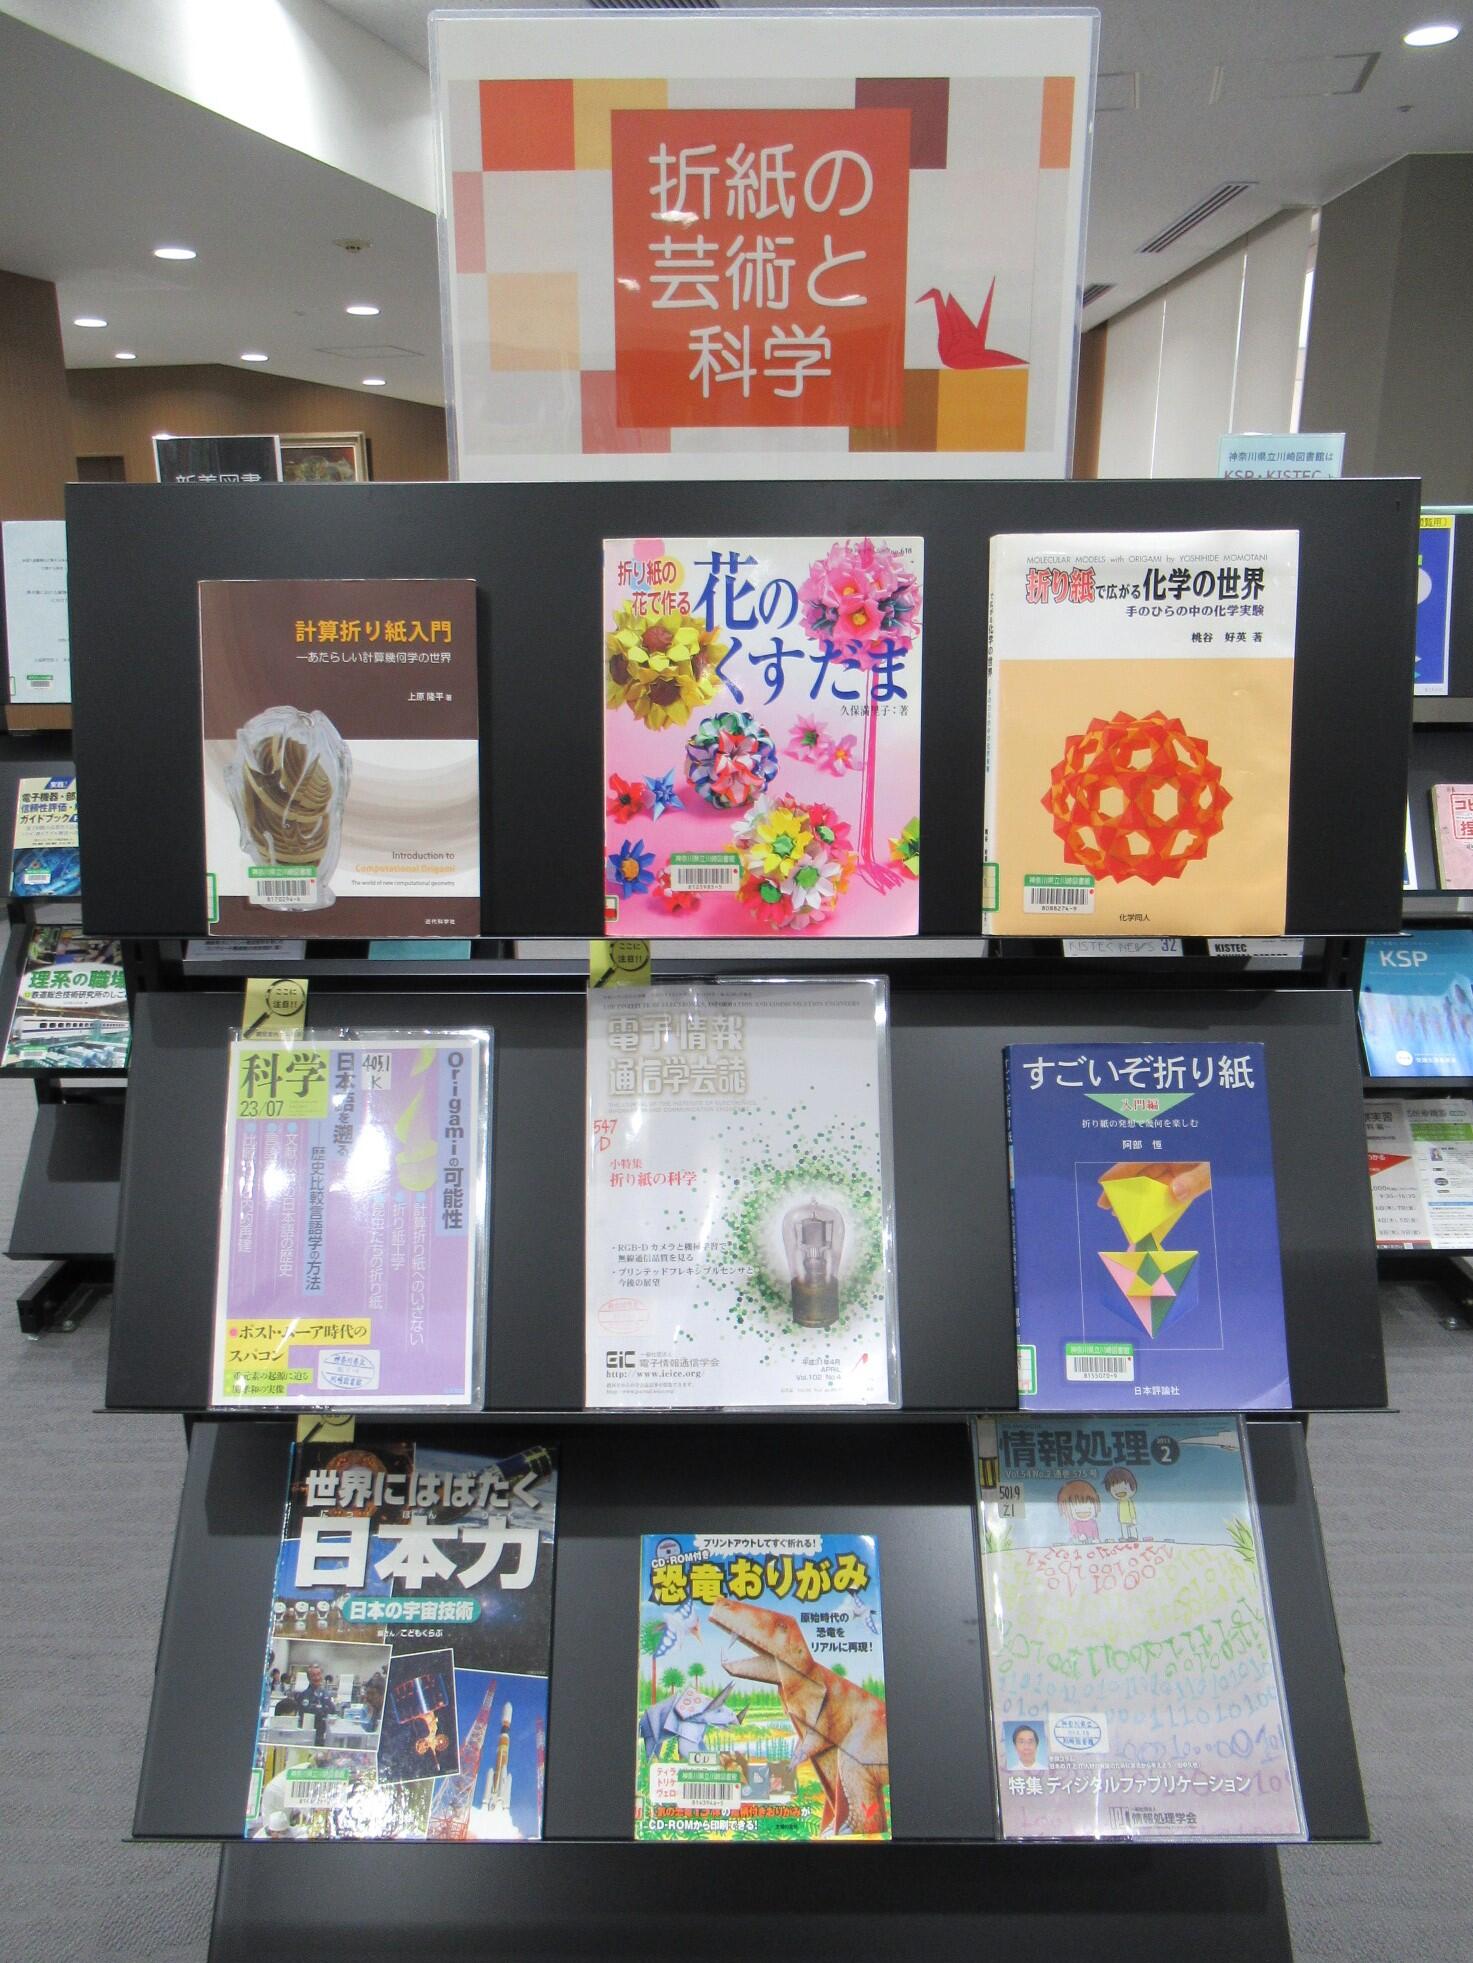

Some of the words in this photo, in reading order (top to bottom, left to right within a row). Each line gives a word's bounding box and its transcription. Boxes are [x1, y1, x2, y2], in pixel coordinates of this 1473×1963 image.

[648, 142, 873, 220] 折紙の
[648, 234, 868, 310] 芸術と
[688, 324, 832, 398] 科学
[1228, 452, 1334, 462] 神奈川県立川崎図書館は
[1026, 556, 1071, 564] MOLECULAR
[1075, 556, 1106, 564] MODELS
[1110, 555, 1124, 564] with
[1128, 554, 1162, 563] ORIGAMI
[1179, 554, 1219, 563] YOSHIHIDE
[1223, 553, 1268, 562] MOMOTANI
[617, 560, 677, 586] 折り紙の
[692, 550, 799, 634] 花の
[1024, 566, 1266, 605] 折り紙で広がる化学の世界
[631, 590, 691, 617] 花で作る
[1125, 604, 1265, 618] 手のひらの中の化学実験
[295, 619, 452, 643] 計算折り紙入門
[1191, 631, 1214, 644] 桃谷
[1224, 631, 1247, 644] 好英
[1251, 631, 1264, 643] 著
[714, 635, 908, 706] くすだま
[407, 692, 425, 702] 上原
[392, 850, 444, 861] Introduction
[446, 852, 455, 861] to
[1118, 913, 1151, 922] 化学同人
[1215, 943, 1248, 953] KISTEC
[1380, 950, 1428, 968] KSP
[607, 1013, 745, 1052] 電子情報
[240, 1052, 328, 1100] 科学
[608, 1056, 748, 1096] 通信学会誌
[1022, 1054, 1255, 1090] すごいぞ折り紙
[371, 1075, 383, 1090] K
[239, 1101, 285, 1117] 23/07
[1119, 1097, 1159, 1112] 入門編
[593, 1119, 618, 1135] 547
[1081, 1118, 1199, 1129] 折り紙の発想で幾何を楽しむ
[442, 1051, 465, 1230] Origamiの可能性
[598, 1136, 611, 1152] D
[1122, 1139, 1143, 1150] 阿部
[610, 1158, 642, 1170] 小特集
[609, 1171, 697, 1188] 折り紙の科学
[618, 1278, 660, 1287] 今後の展望
[230, 1349, 284, 1362] スパコン
[1134, 1386, 1181, 1396] 日本評論社
[1000, 1429, 1151, 1468] 情報処理
[1160, 1446, 1173, 1463] 2
[305, 1468, 540, 1509] 世界にはばたく
[294, 1515, 540, 1591] 日本力
[652, 1552, 869, 1605] 恐竜おりがみ
[350, 1601, 474, 1621] 日本の宇宙技術
[800, 1611, 850, 1624] 原始時代の
[816, 1626, 846, 1638] 恐竜を
[1008, 1775, 1043, 1796] 特集
[1047, 1775, 1252, 1795] ディジタルファブリケーション
